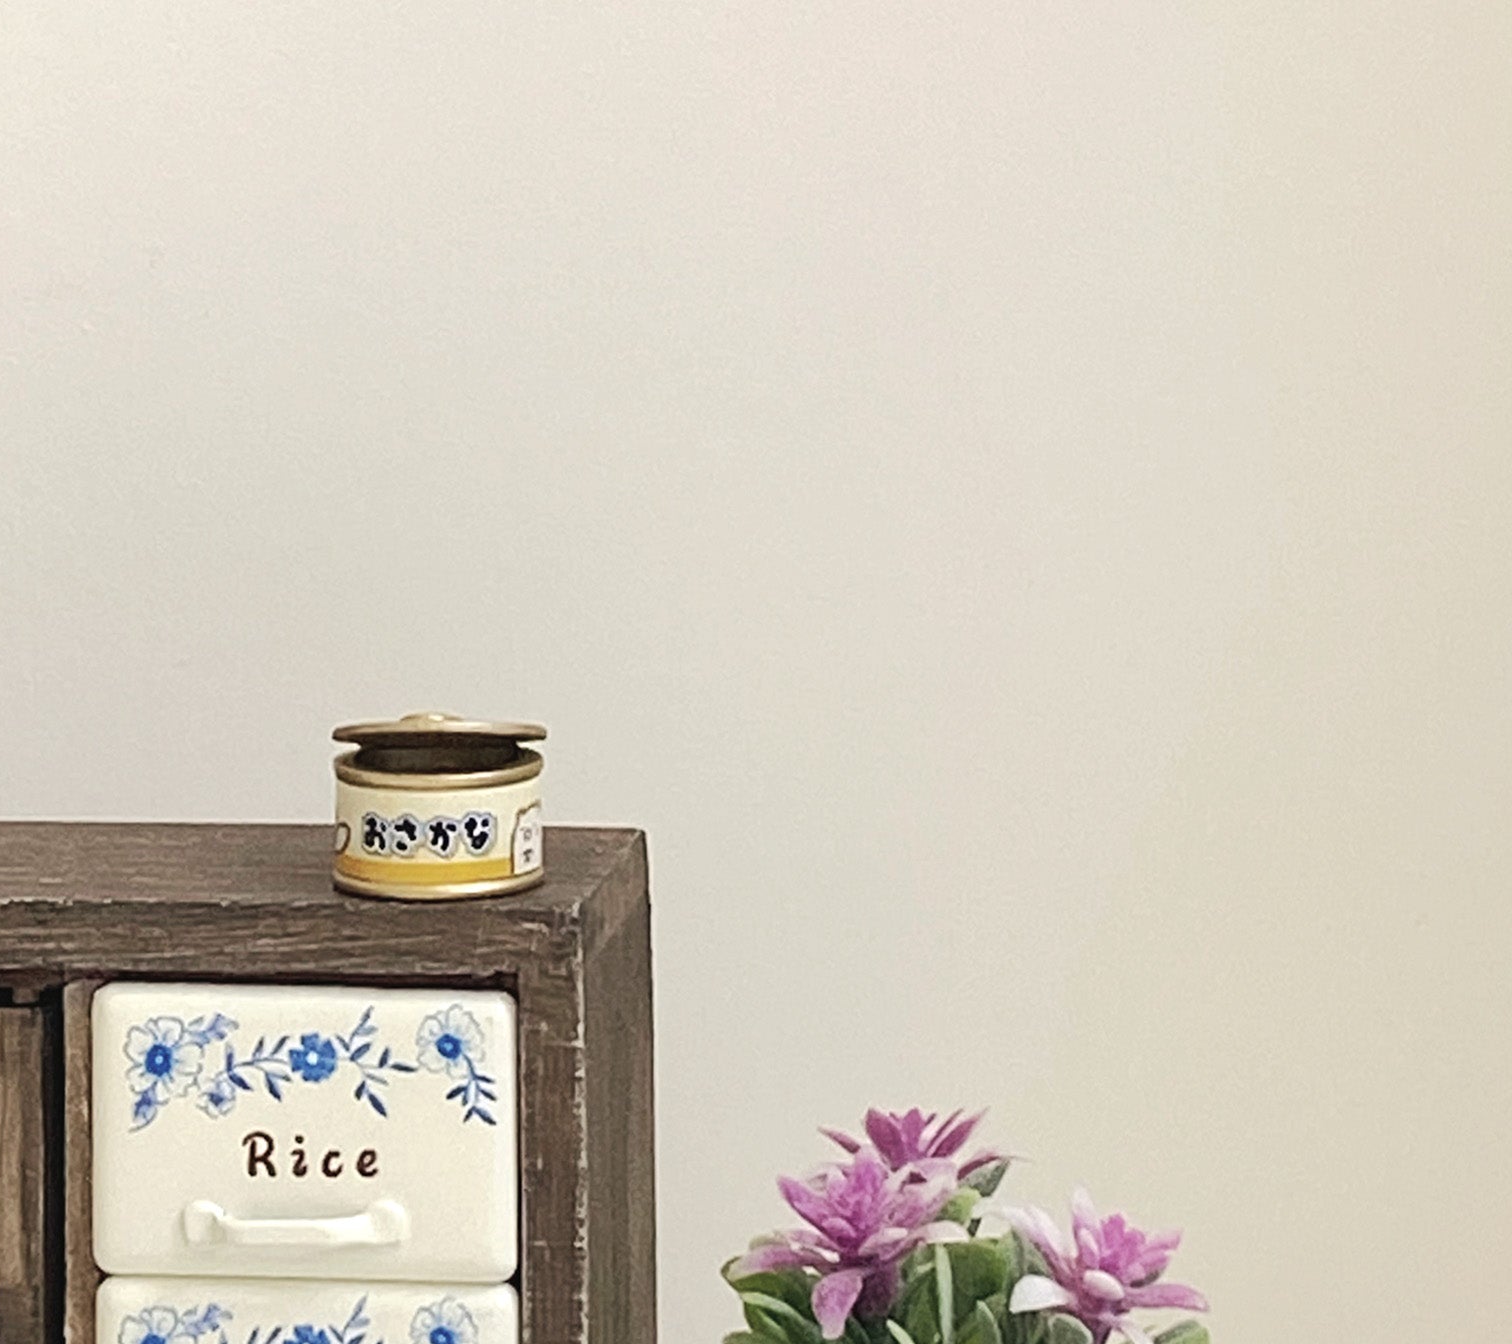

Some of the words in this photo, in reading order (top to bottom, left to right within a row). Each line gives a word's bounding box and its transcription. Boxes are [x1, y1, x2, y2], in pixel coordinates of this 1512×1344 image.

[363, 815, 492, 853] おさかな
[241, 1129, 381, 1180] Rice
